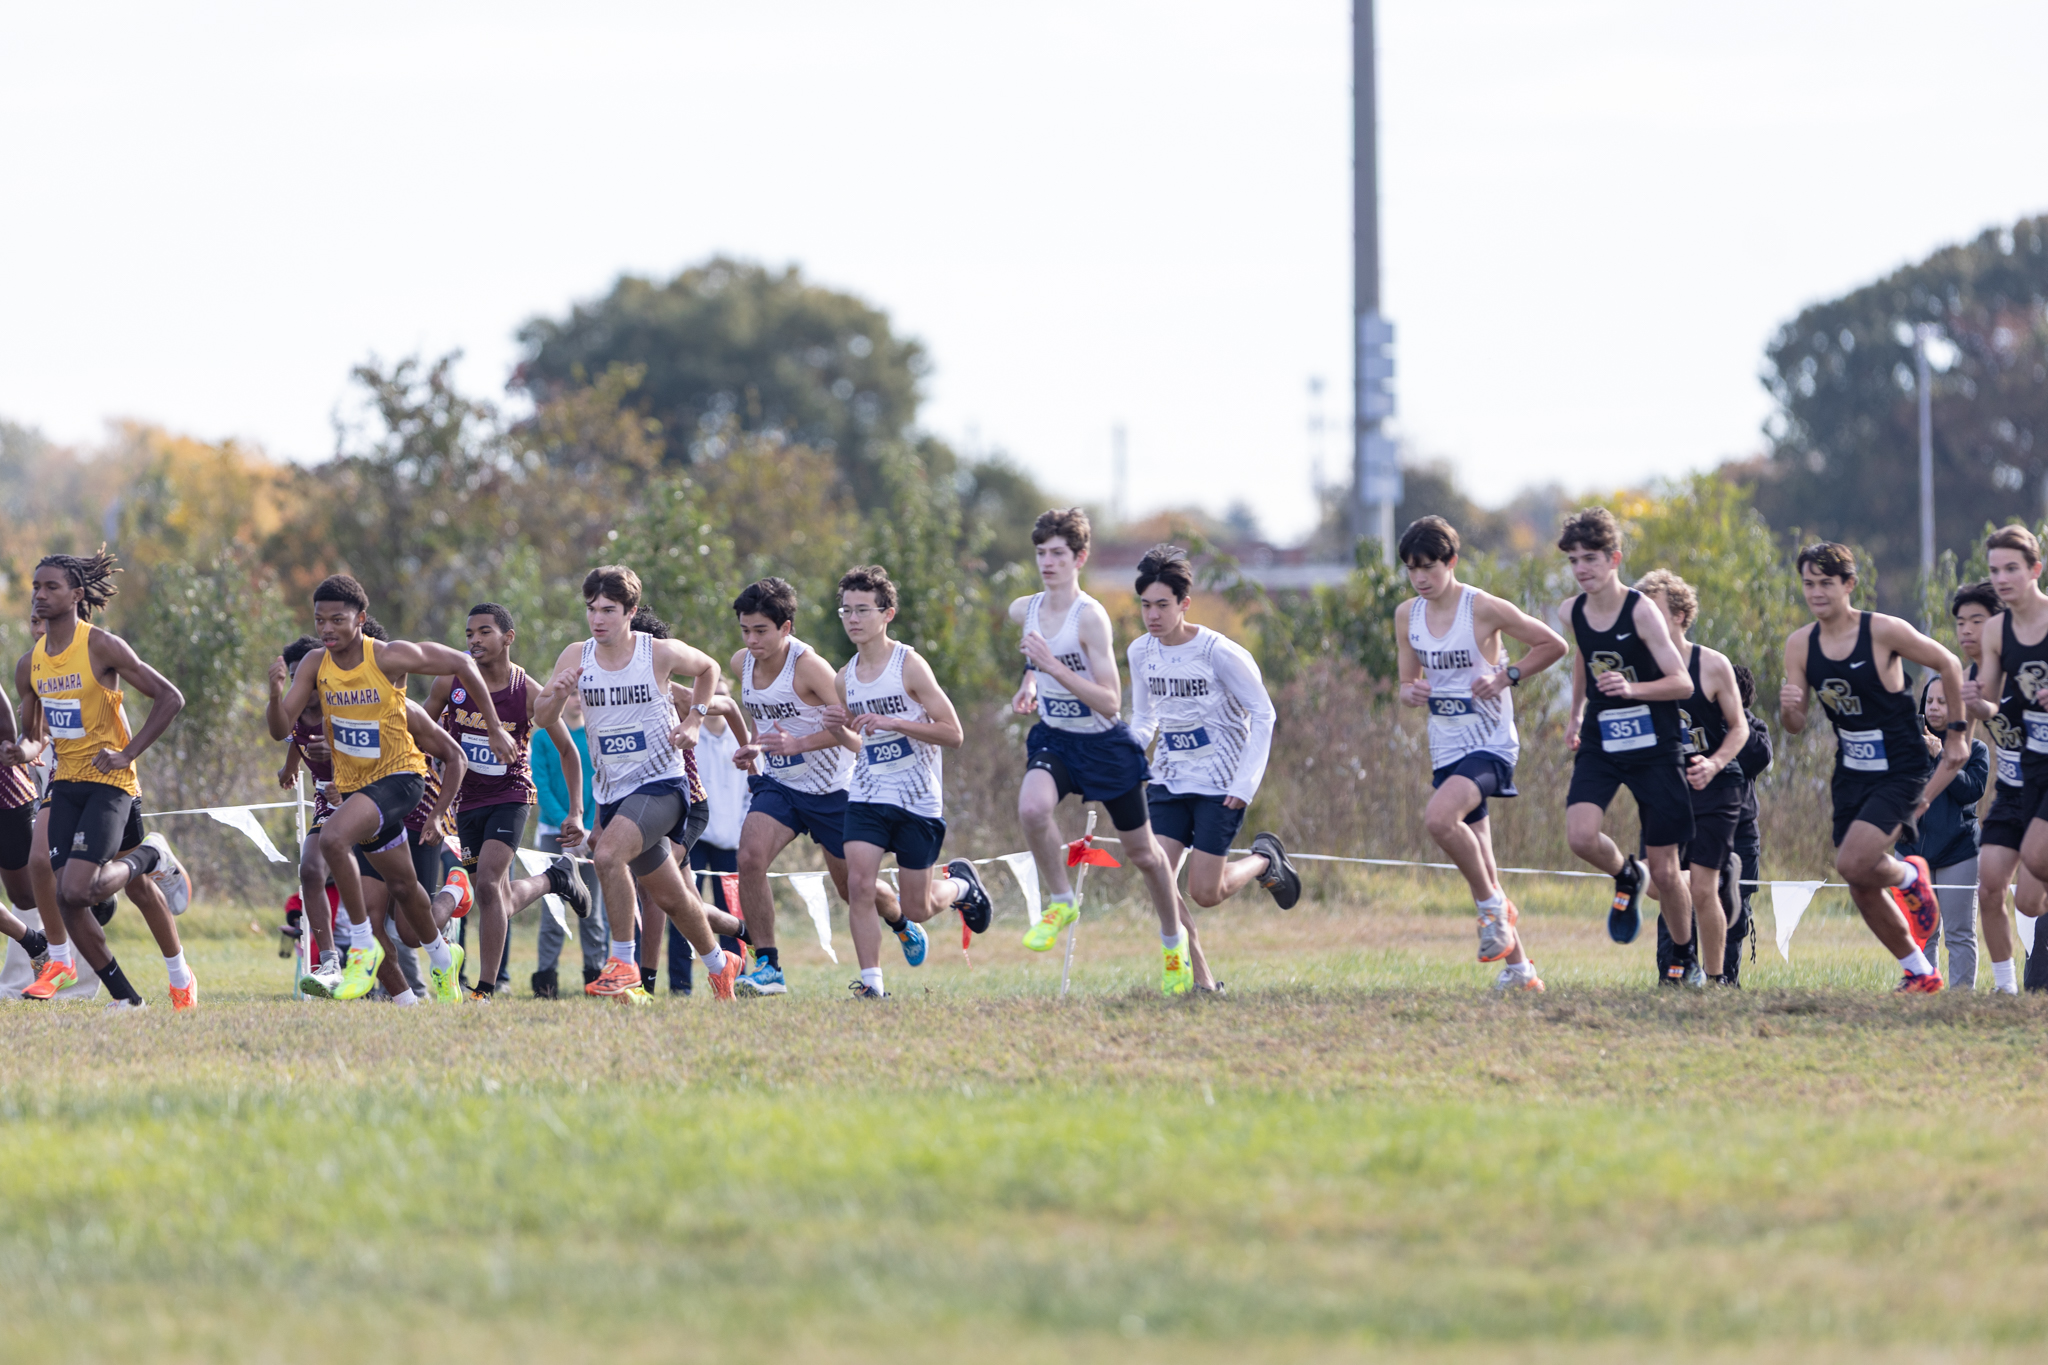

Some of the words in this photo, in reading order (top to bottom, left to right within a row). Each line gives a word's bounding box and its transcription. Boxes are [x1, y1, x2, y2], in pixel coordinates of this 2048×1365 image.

[609, 683, 652, 706] COUNSEL
[1049, 700, 1081, 717] 293
[1434, 699, 1467, 715] 290
[49, 710, 72, 727] 107
[1610, 719, 1642, 738] 351
[339, 729, 370, 746] 113
[604, 735, 637, 753] 296
[1172, 733, 1199, 749] 301
[873, 743, 902, 761] 299
[1846, 742, 1876, 759] 350
